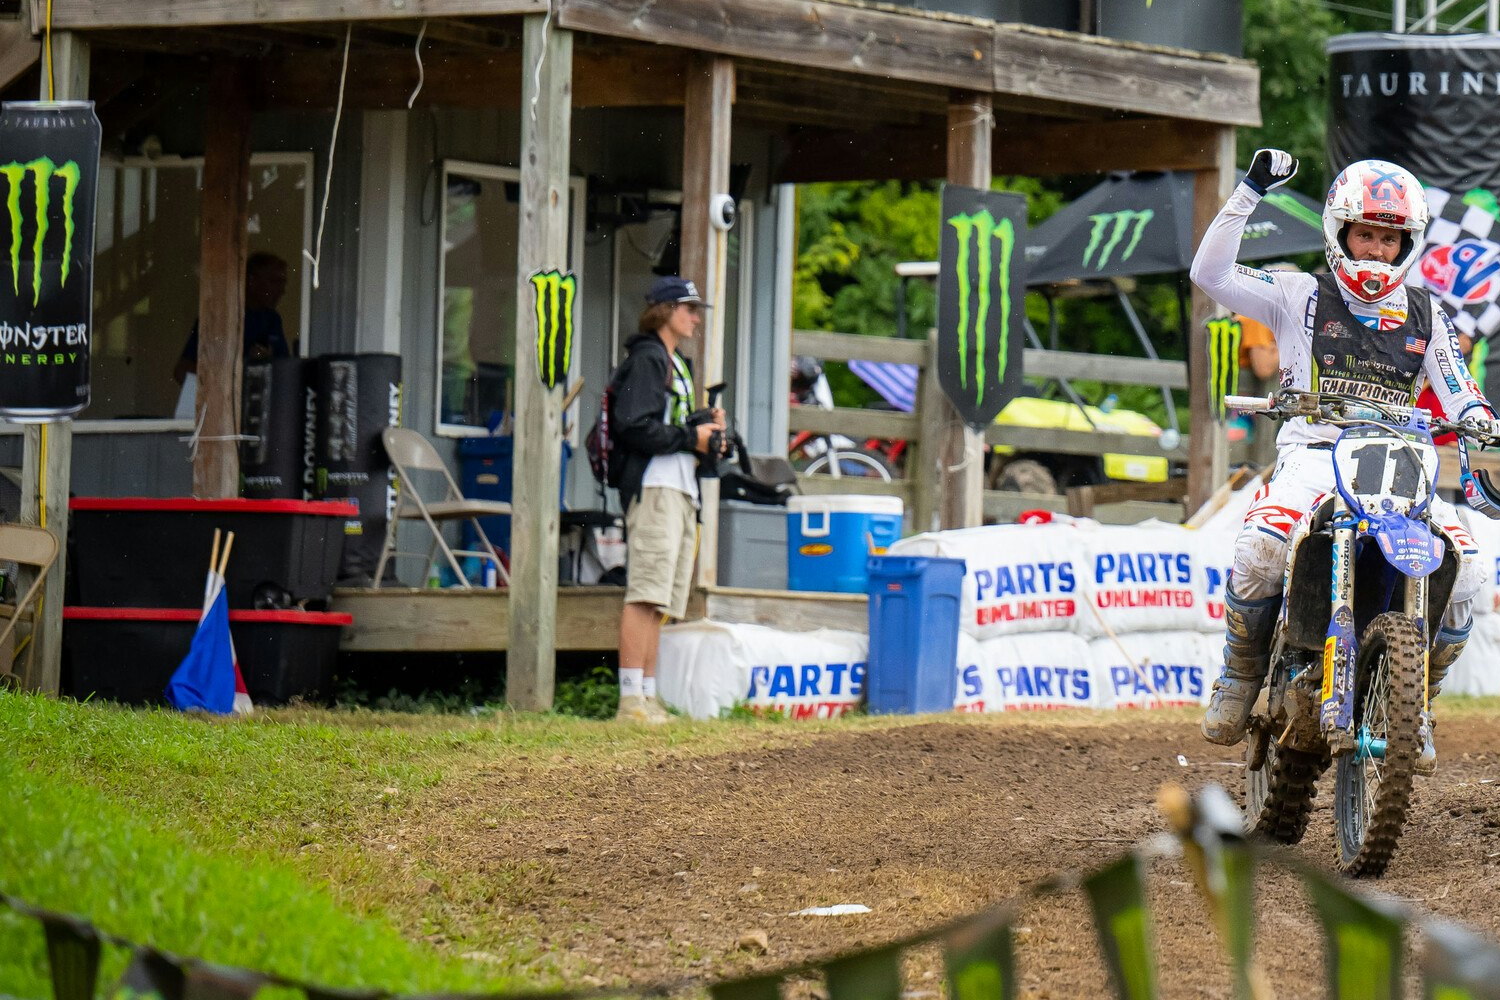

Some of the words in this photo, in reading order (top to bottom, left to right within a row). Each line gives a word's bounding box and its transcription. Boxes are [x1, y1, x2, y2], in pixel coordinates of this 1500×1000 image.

[14, 116, 77, 129] TAURINE
[0, 321, 88, 350] ONSTER
[0, 352, 78, 366] NERGY
[1351, 443, 1424, 499] 11
[974, 562, 1076, 600] PARTS
[1096, 553, 1192, 584] PARTS
[976, 599, 1076, 626] UNLIMITED
[1097, 589, 1194, 609] UNLIMITED
[748, 662, 866, 697] PARTS
[997, 666, 1090, 700] PARTS
[1110, 664, 1203, 697] PARTS
